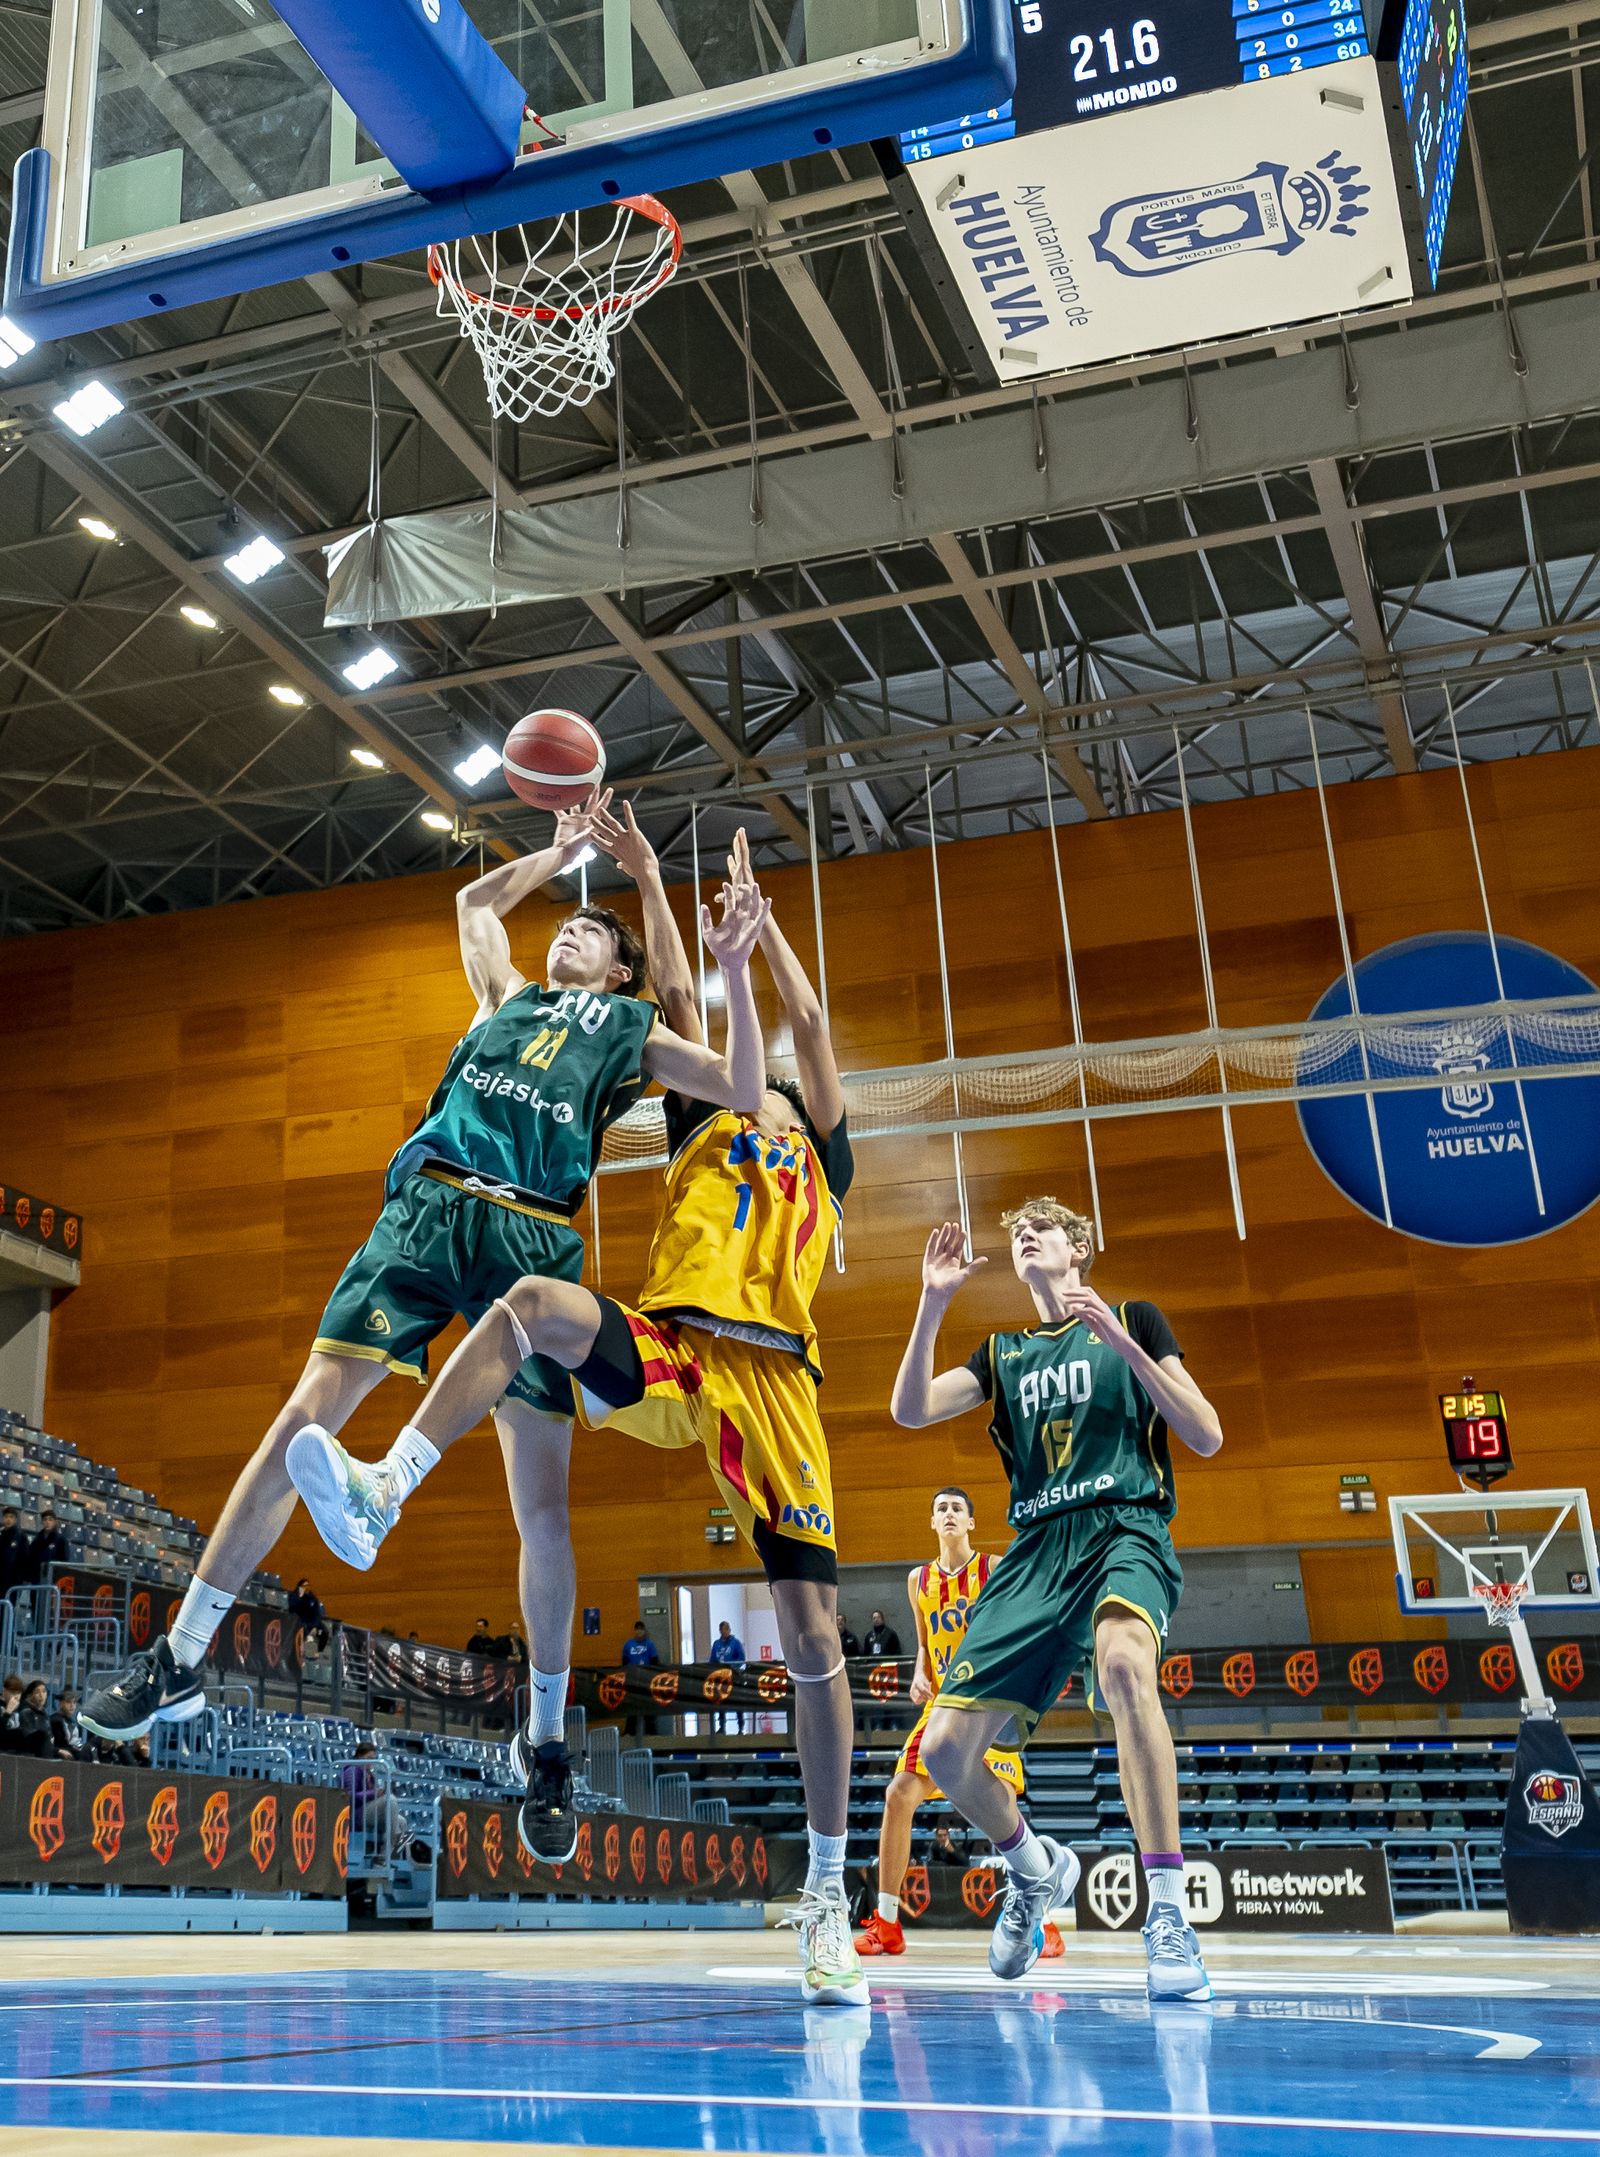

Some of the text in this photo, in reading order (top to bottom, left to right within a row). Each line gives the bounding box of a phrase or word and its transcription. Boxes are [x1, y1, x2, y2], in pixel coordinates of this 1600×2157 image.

[1020, 2, 1043, 34] 5
[1282, 0, 1354, 26] 0 24
[1070, 19, 1160, 82] 21.6
[1254, 19, 1358, 57] 2 0 34
[1258, 42, 1361, 79] 8 2 60
[1092, 76, 1177, 110] MONDO
[910, 133, 974, 160] 15 0
[1141, 183, 1245, 212] PORTUS MARIS
[1260, 192, 1273, 201] ET
[949, 191, 1050, 341] HUELVA
[1014, 185, 1094, 327] Ayuntamiento de
[1175, 242, 1242, 261] CUSTODIA
[1427, 1119, 1521, 1140] Ayuntamiento de
[1428, 1133, 1525, 1160] HUELVA
[1019, 1359, 1092, 1419] AND
[1042, 1419, 1073, 1475] 15
[1469, 1421, 1500, 1456] 19
[1014, 1481, 1092, 1519] cajasur
[1532, 1803, 1581, 1820] ESPAÑA
[1230, 1866, 1367, 1897] finetwork
[1235, 1898, 1325, 1915] FIBRA Y MÓVIL
